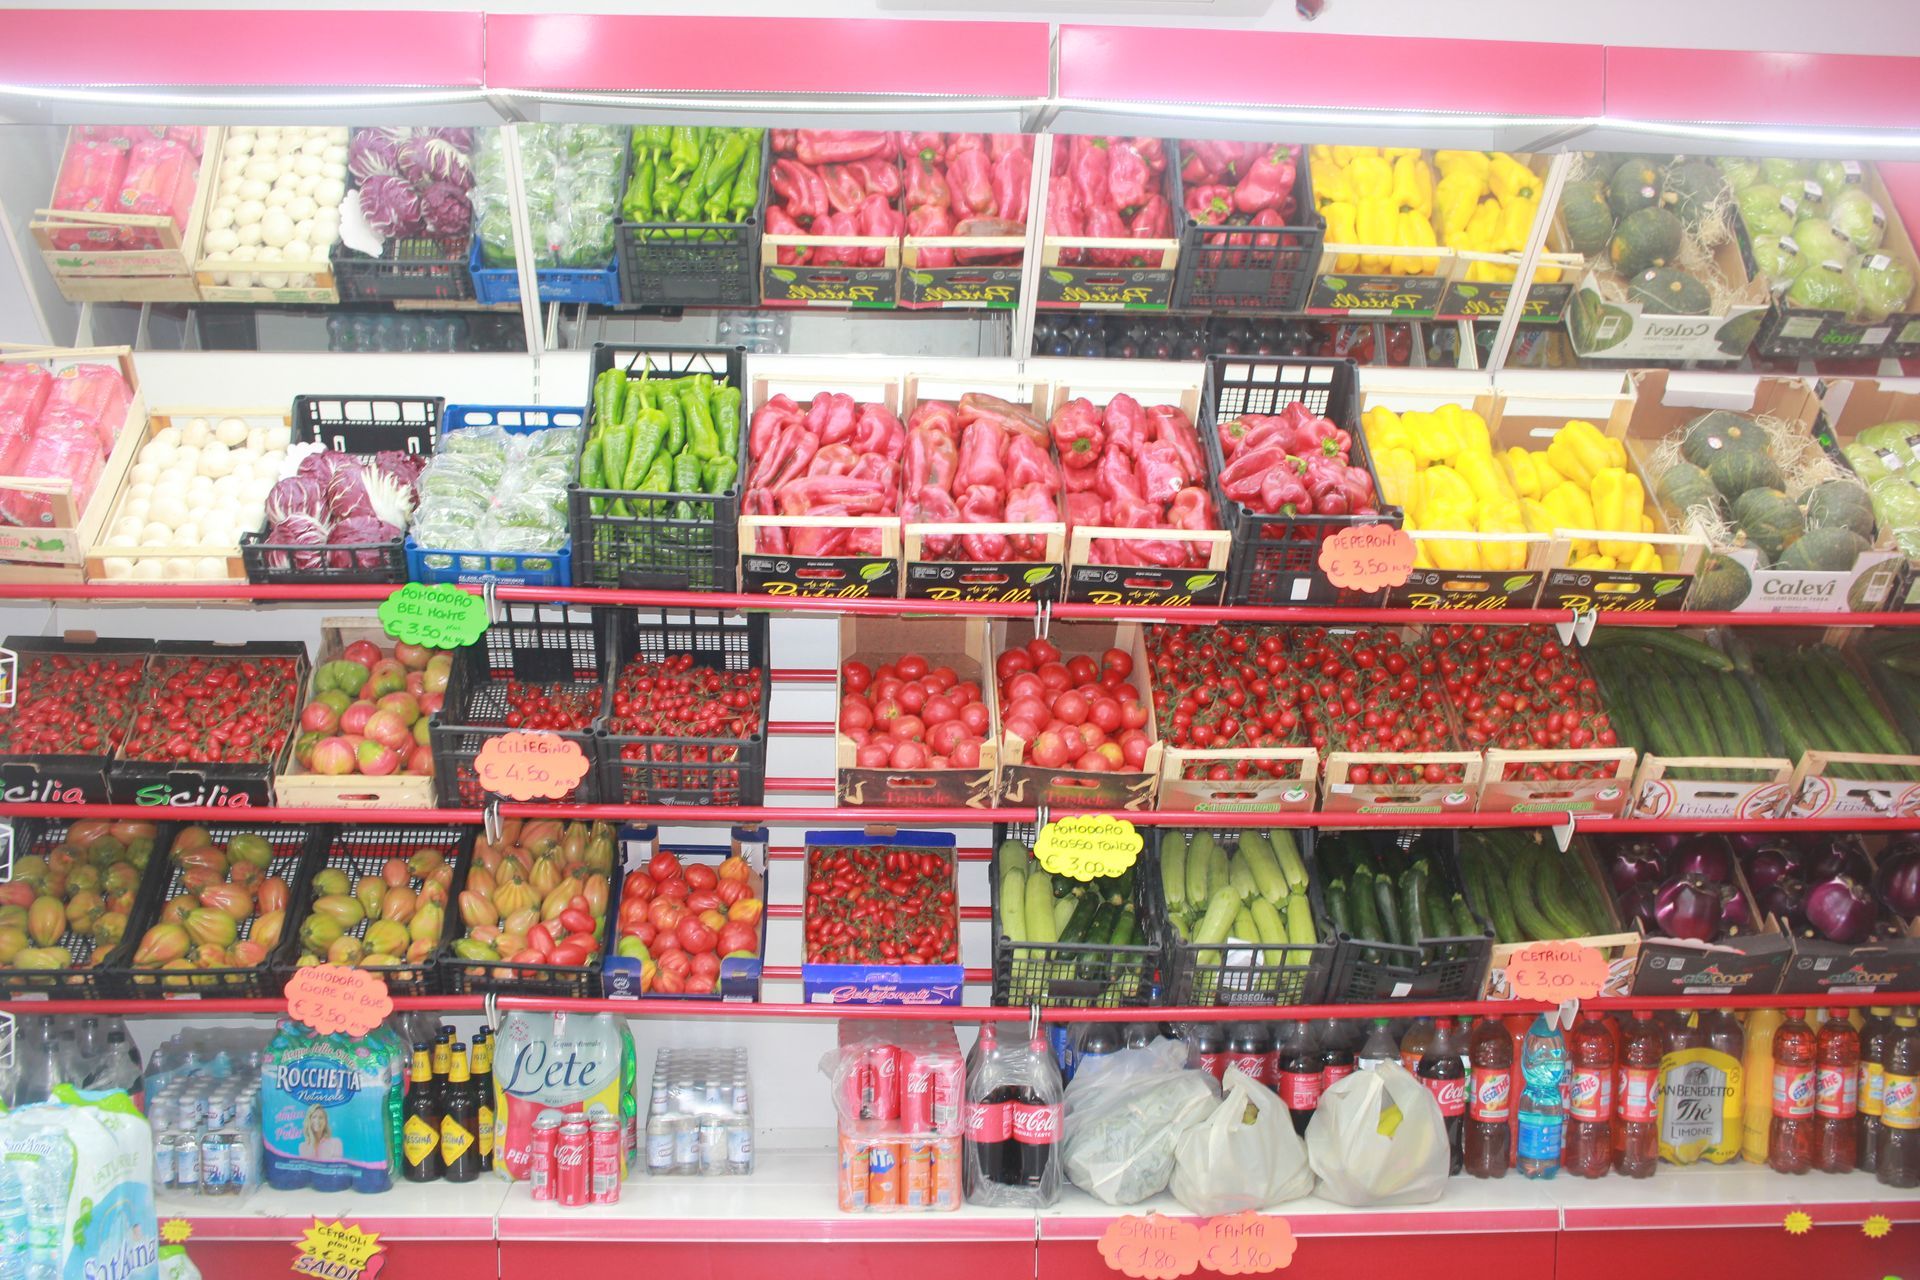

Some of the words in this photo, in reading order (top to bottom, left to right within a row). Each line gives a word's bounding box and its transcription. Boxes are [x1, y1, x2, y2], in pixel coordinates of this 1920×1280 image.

[1763, 579, 1837, 596] Calevi
[402, 588, 472, 608] POMODORO
[398, 602, 423, 616] BEL
[484, 763, 498, 780] €
[135, 783, 252, 808] Sicilia
[1053, 823, 1123, 836] POMODORO
[1051, 838, 1093, 850] ROSSO
[1517, 970, 1530, 986] €
[501, 1040, 597, 1097] Lete
[276, 1065, 361, 1092] ROCCHETTA
[1677, 1084, 1735, 1097] BENEDETTO
[1120, 1222, 1177, 1241] SPRITE
[1215, 1222, 1265, 1239] FANTA
[297, 1257, 358, 1280] SALDI
